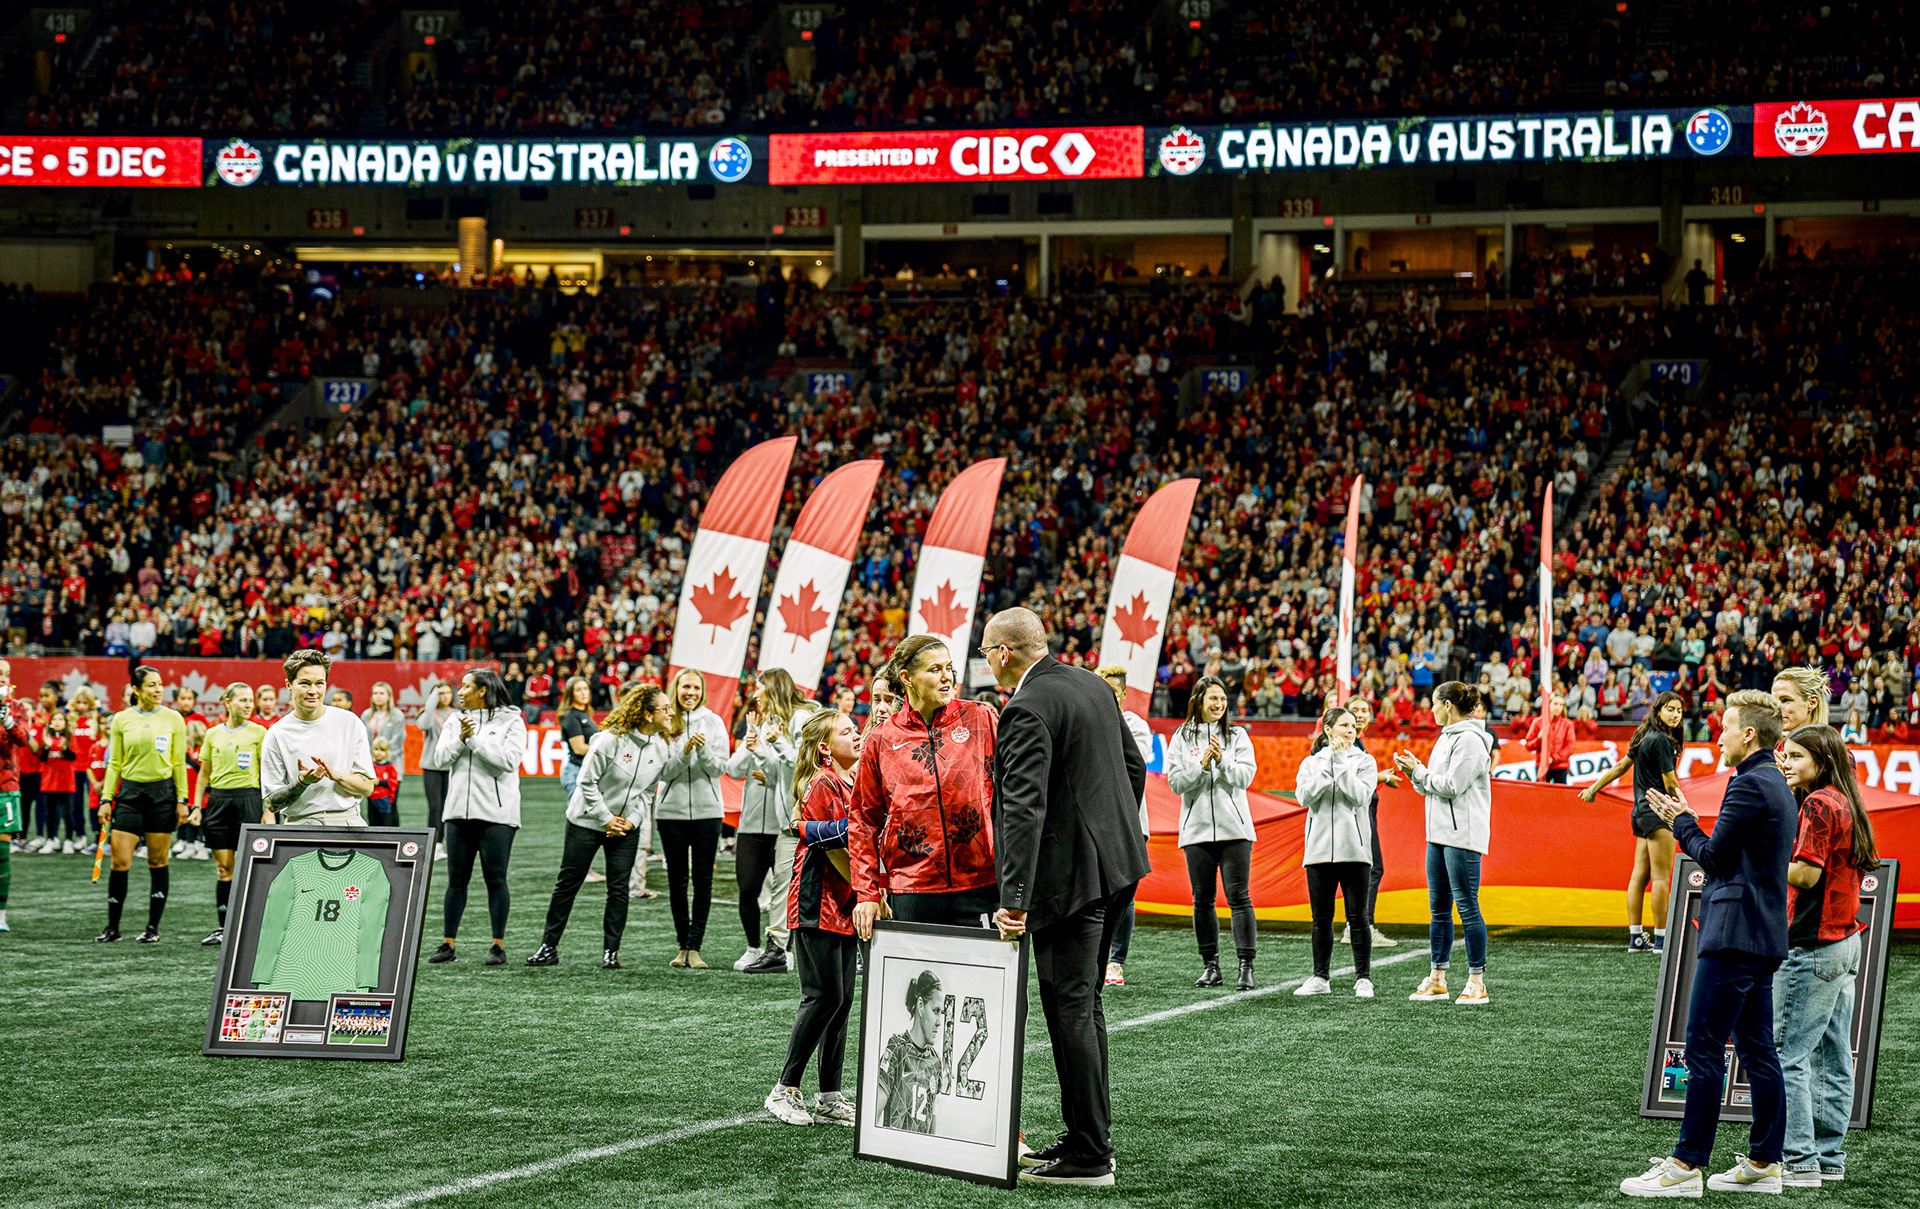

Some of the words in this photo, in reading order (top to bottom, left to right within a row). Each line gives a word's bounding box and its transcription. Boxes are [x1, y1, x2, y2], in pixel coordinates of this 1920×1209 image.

[1180, 0, 1211, 18] 439
[44, 13, 76, 32] 436
[414, 15, 445, 34] 437
[1218, 124, 1392, 169] CANADA
[1428, 114, 1674, 162] AUSTRALIA
[67, 146, 89, 177] 5
[97, 146, 166, 178] DEC
[274, 144, 441, 182] CANADA
[473, 142, 700, 181] AUSTRALIA
[814, 148, 912, 167] PRESENTED
[914, 147, 939, 165] BY
[950, 135, 1049, 176] CIBC
[1710, 185, 1742, 206] 340
[1283, 198, 1313, 218] 339
[329, 382, 361, 403] 237
[5, 801, 14, 821] 1
[315, 899, 341, 922] 18
[939, 993, 989, 1101] 12
[911, 1083, 928, 1122] 12
